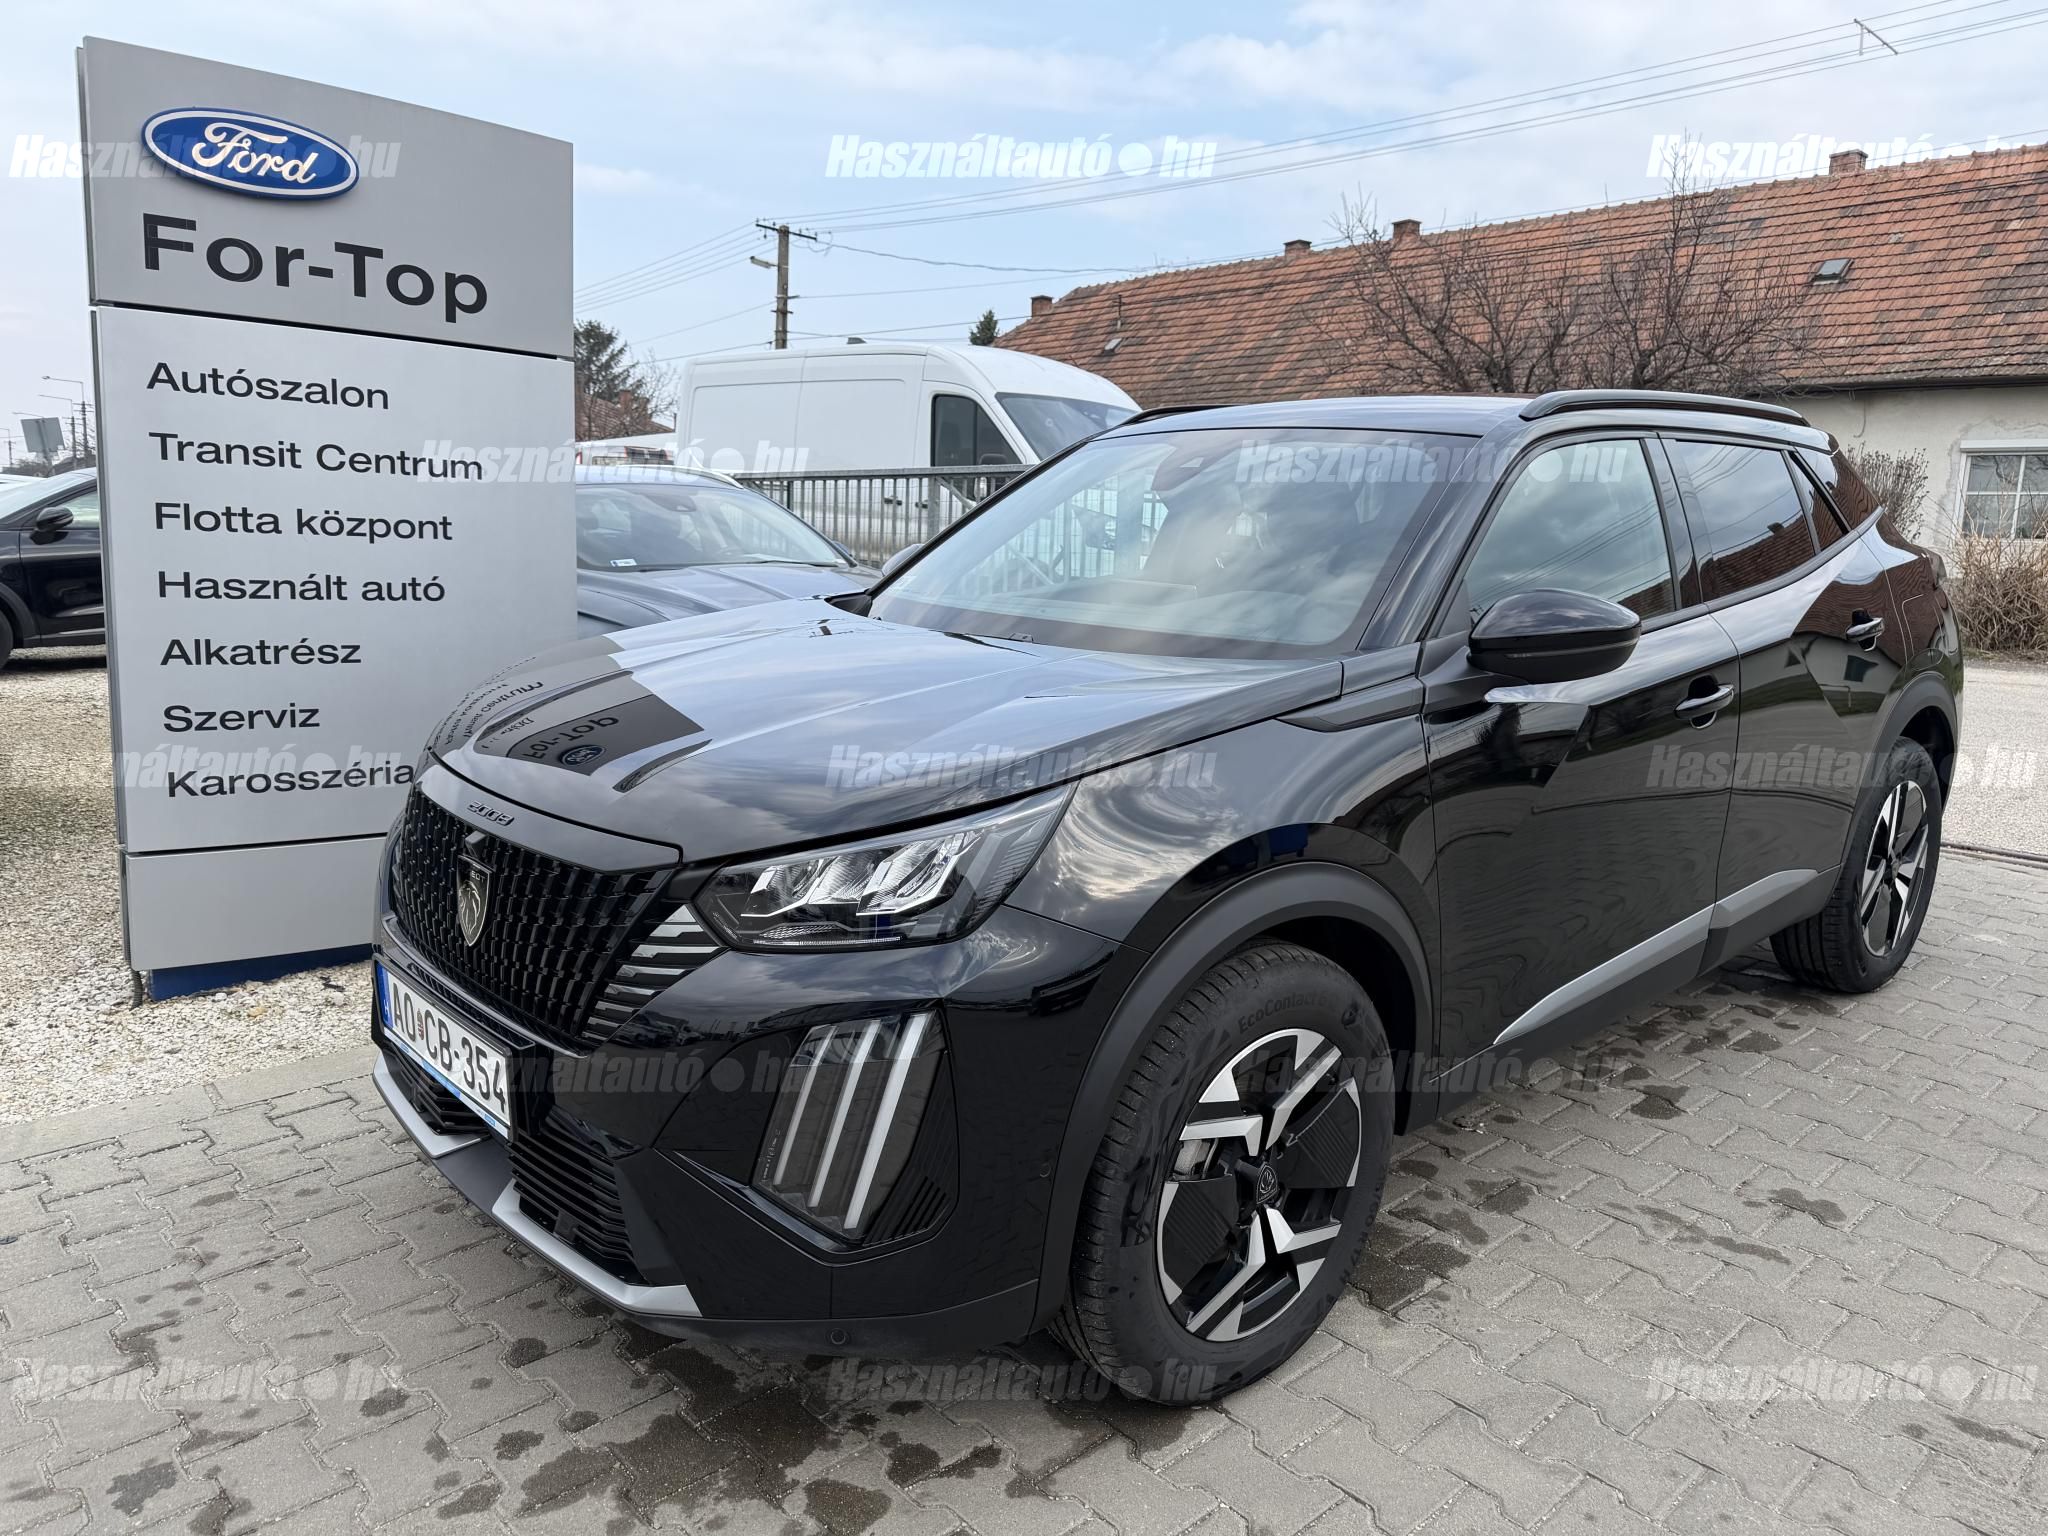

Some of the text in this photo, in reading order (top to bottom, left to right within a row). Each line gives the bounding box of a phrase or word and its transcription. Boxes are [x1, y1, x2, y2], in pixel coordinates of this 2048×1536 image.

[191, 121, 320, 184] Ford
[142, 212, 488, 324] For-Top
[147, 362, 389, 410] Autószalon
[149, 431, 482, 481] Transit Centrum
[155, 502, 453, 544] Flotta központ
[158, 571, 445, 602] Használt autó
[160, 637, 362, 666] Alkatrész
[163, 702, 320, 733] Szerviz
[167, 760, 414, 798] Karosszéria
[392, 982, 417, 1043] AO
[423, 1008, 507, 1115] CB-354
